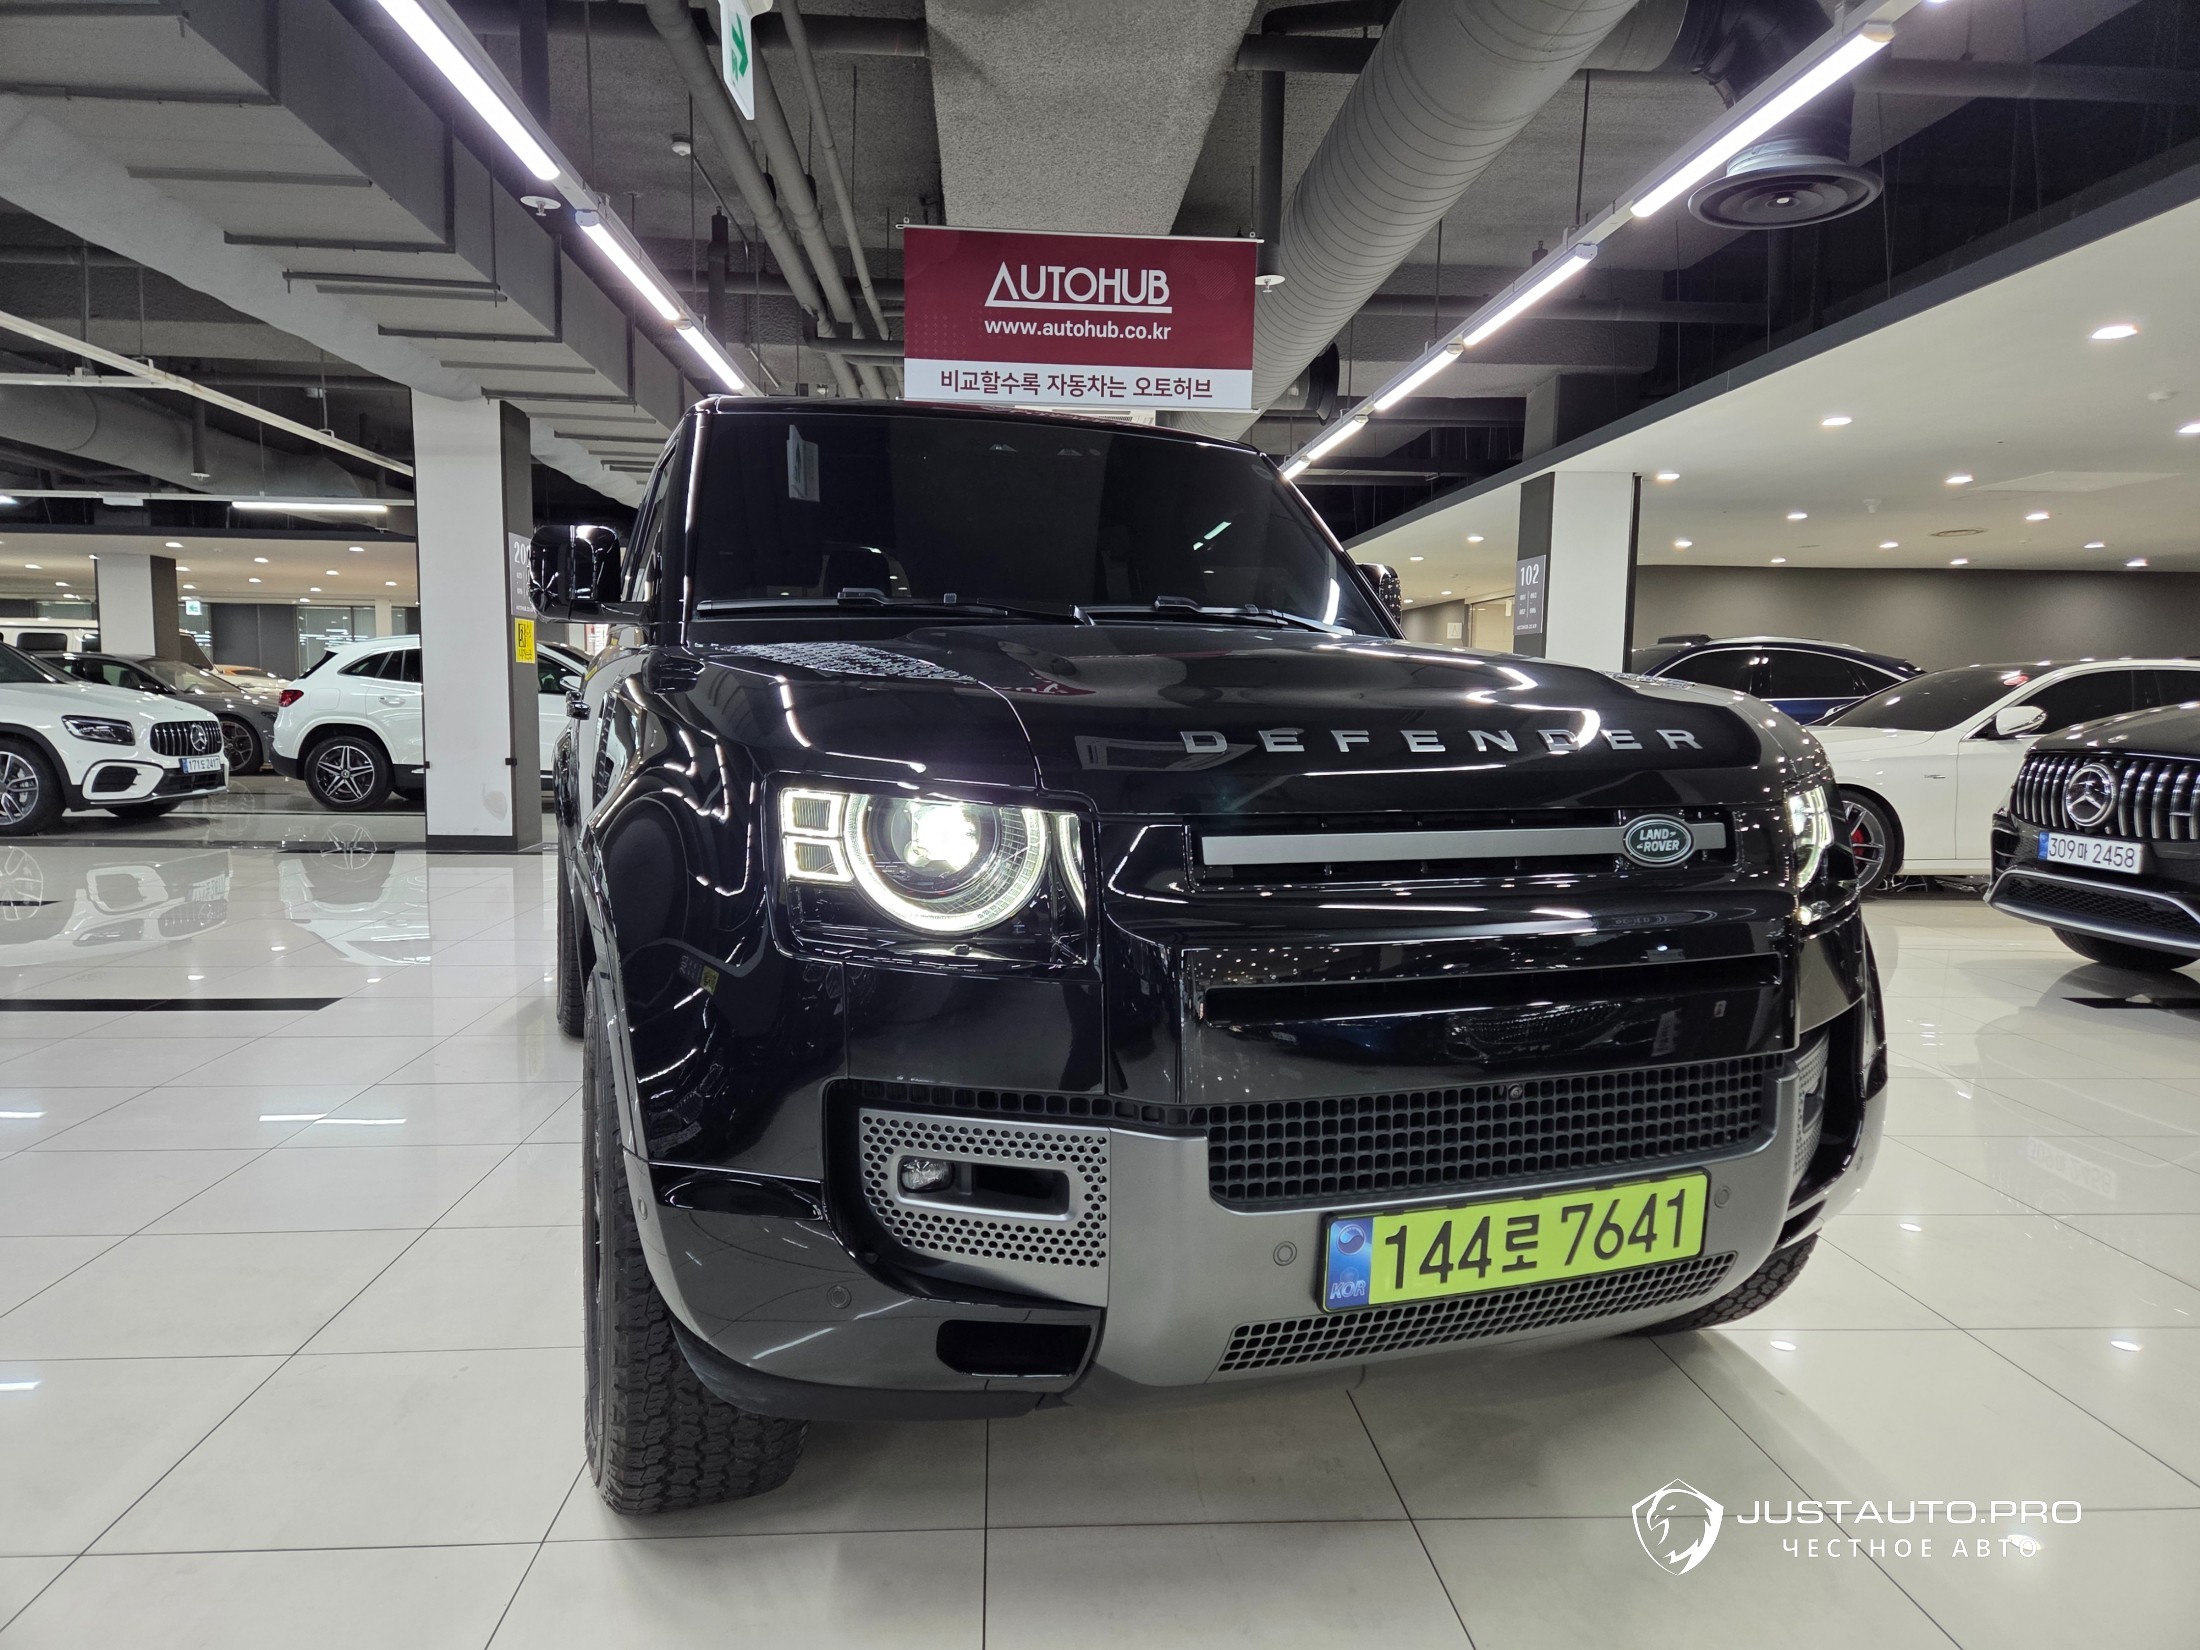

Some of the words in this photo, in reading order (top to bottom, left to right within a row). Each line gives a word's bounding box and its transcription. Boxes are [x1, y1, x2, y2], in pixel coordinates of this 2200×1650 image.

[984, 261, 1172, 314] AUTOHUB
[984, 318, 1171, 341] www.autohub.co.kr
[941, 370, 1040, 395] 비교할수록
[1047, 373, 1127, 398] 자동차는
[1133, 377, 1213, 400] 오토허브
[1520, 563, 1540, 587] 102
[1180, 729, 1703, 754] DEFENDER
[1639, 829, 1670, 841] LAND
[1643, 840, 1680, 852] ROVER
[1329, 1279, 1367, 1300] KOR
